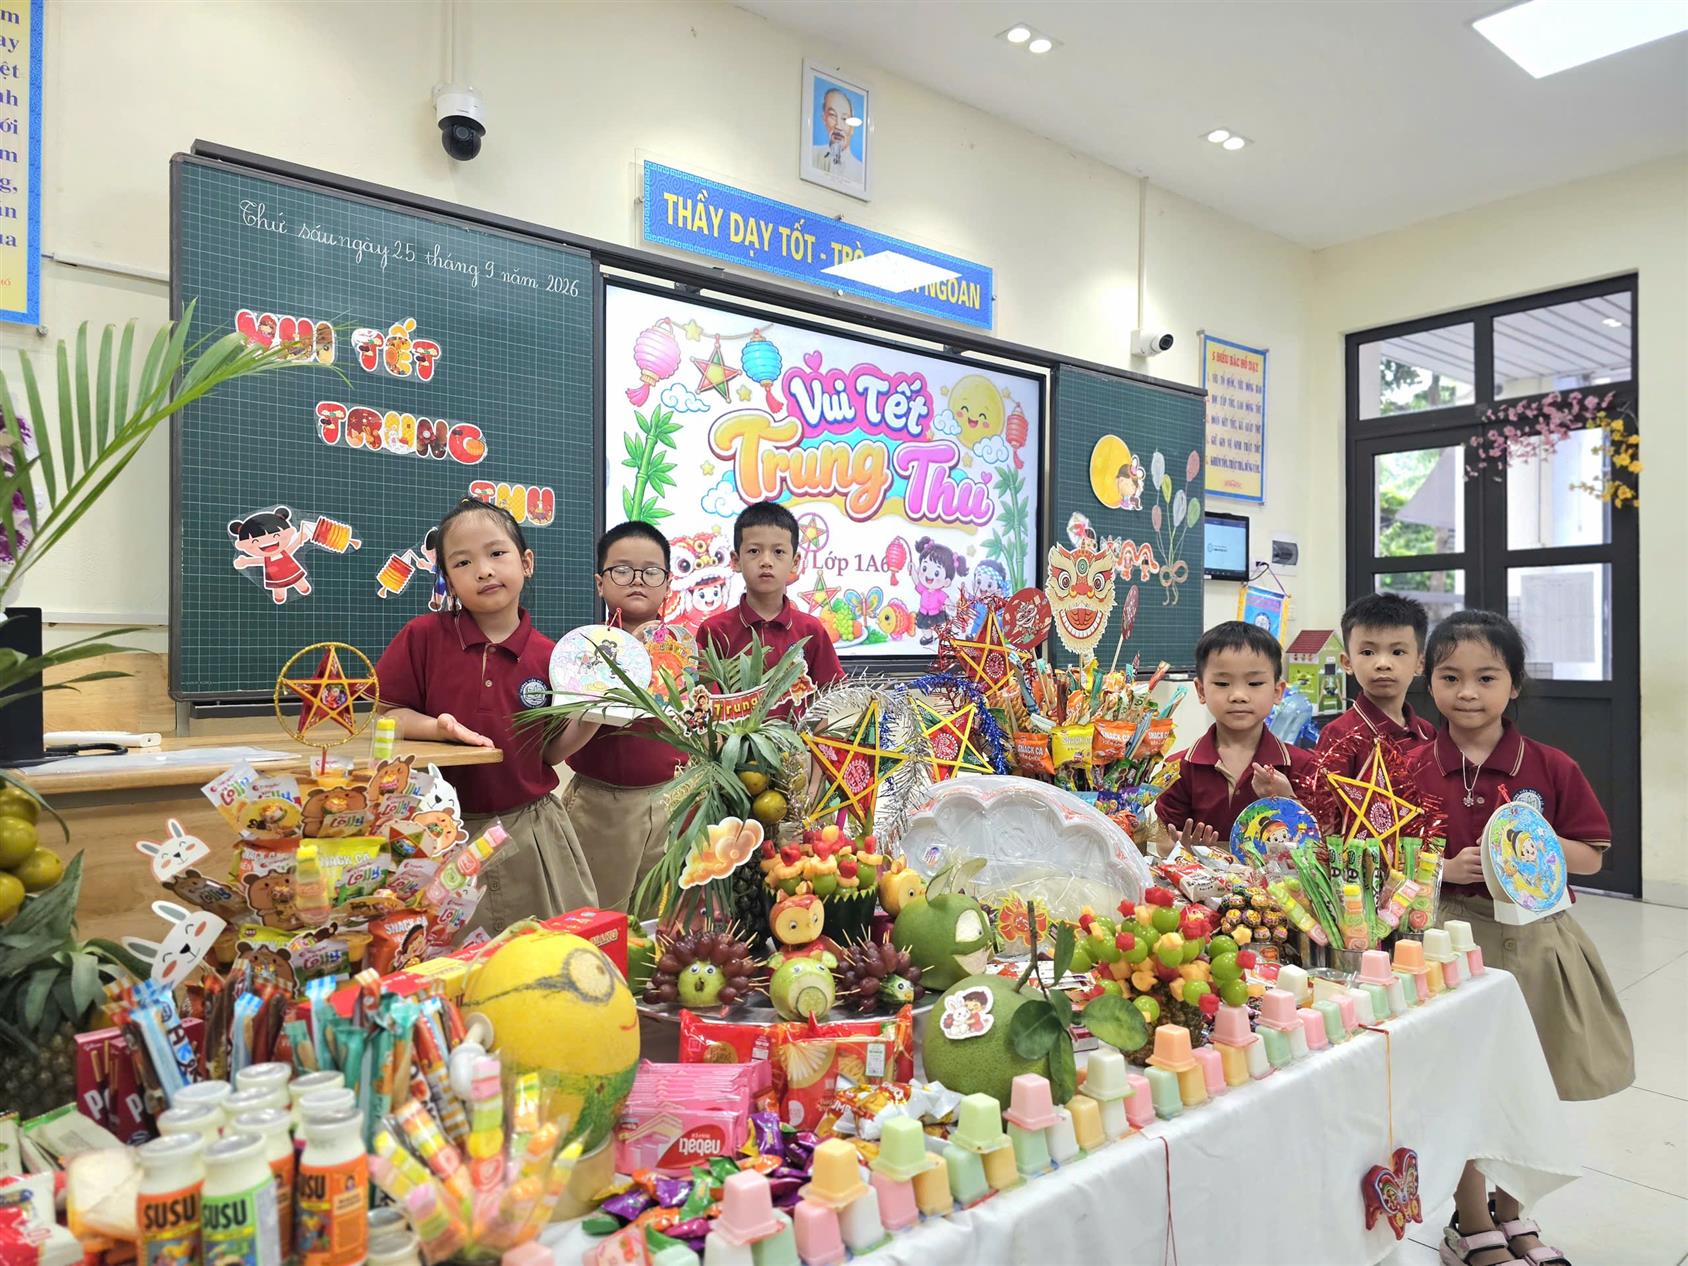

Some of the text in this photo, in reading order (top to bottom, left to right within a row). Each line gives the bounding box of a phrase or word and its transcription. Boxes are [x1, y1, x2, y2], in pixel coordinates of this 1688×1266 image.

[239, 199, 580, 298] Thứ sáu ngày 25 tháng 9 năm 2026
[663, 189, 723, 238] THẦY
[729, 211, 773, 257] DẠY
[779, 219, 816, 264] TỐT
[351, 317, 441, 381] TẾT
[789, 371, 930, 437] Vui Tết
[711, 412, 993, 524] Trung Thu
[811, 551, 849, 576] Lớp
[679, 1137, 721, 1157] nabati
[143, 1194, 197, 1231] SUSU
